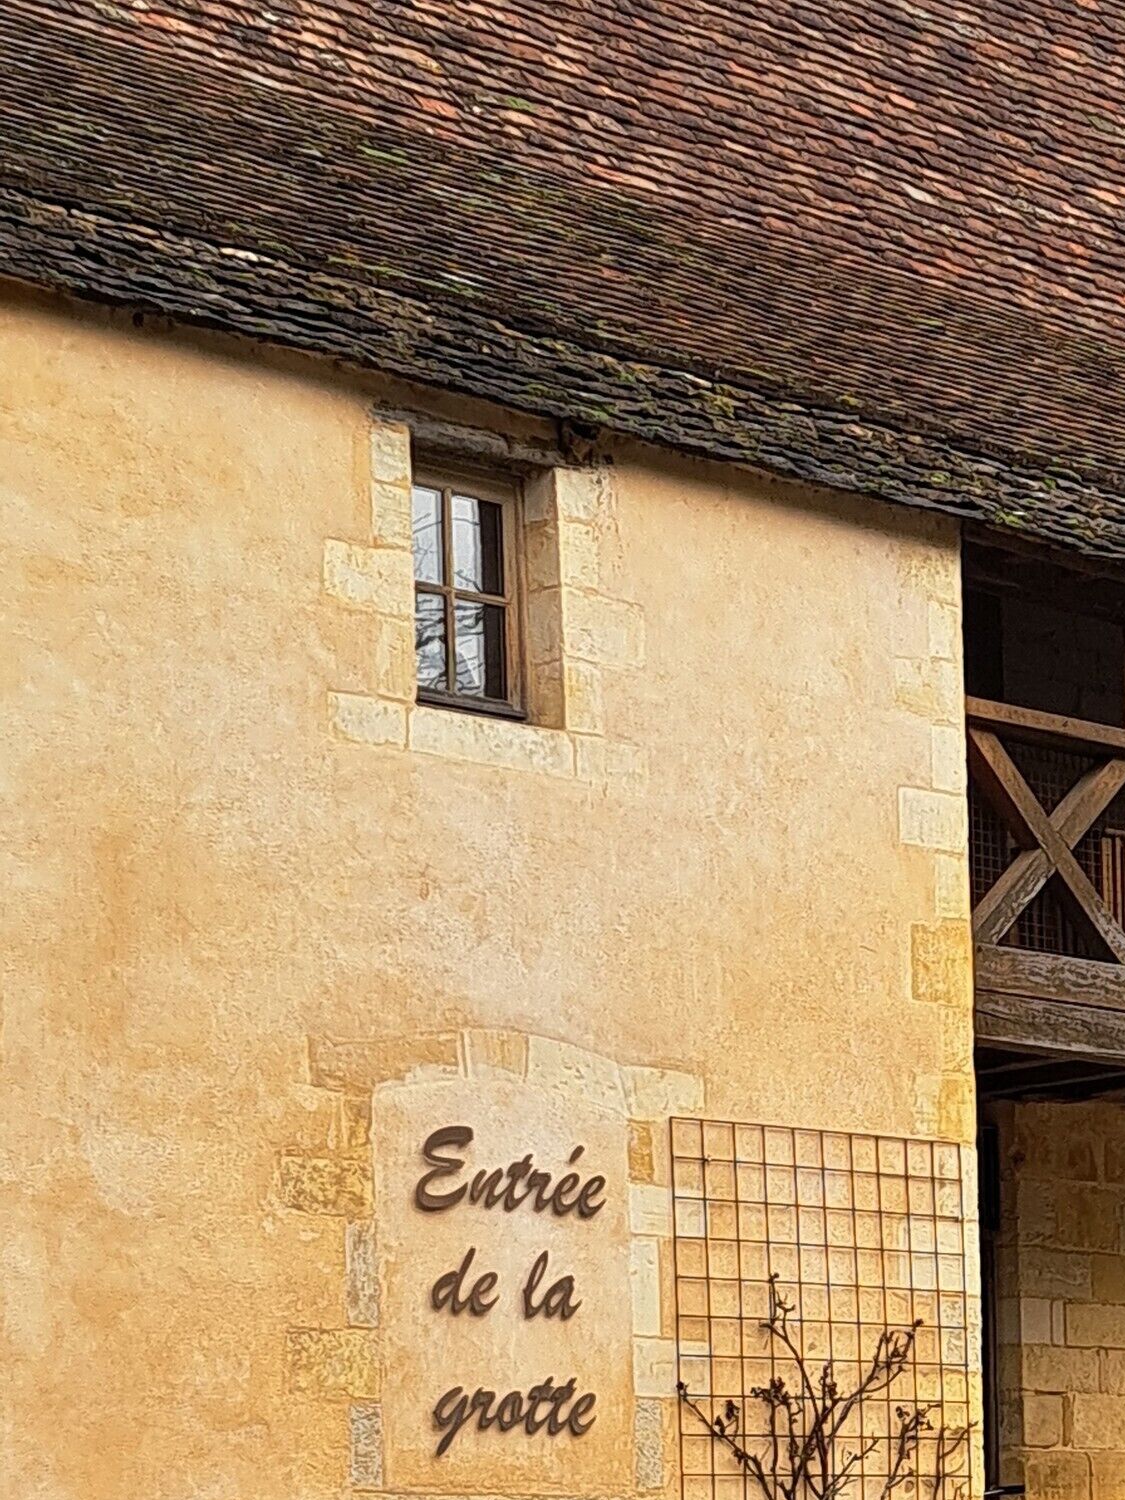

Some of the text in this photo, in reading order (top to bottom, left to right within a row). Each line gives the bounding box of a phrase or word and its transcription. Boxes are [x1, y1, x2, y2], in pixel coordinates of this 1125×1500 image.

[415, 1125, 607, 1219] Entrée
[431, 1246, 583, 1321] de la
[433, 1376, 597, 1457] grotte
